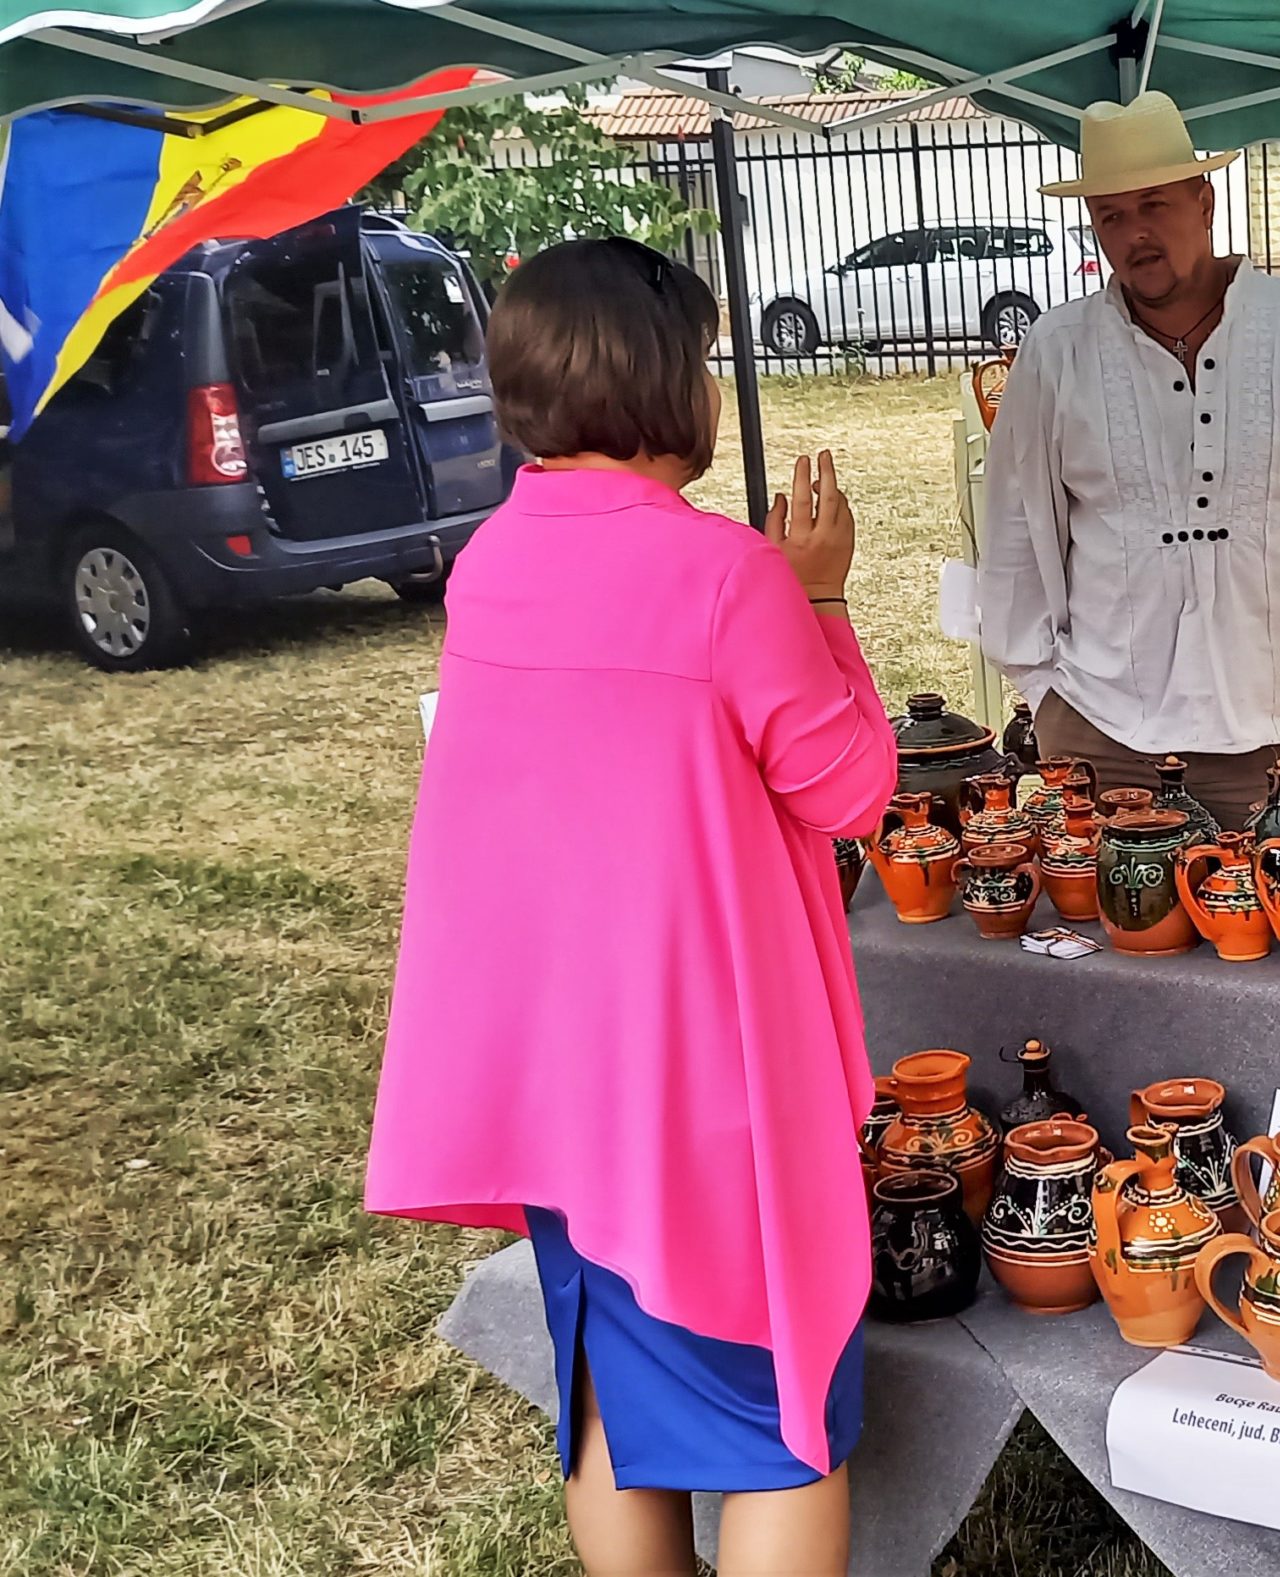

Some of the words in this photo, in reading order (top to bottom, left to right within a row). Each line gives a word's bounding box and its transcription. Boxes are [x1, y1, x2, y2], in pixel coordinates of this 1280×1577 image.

[339, 434, 374, 462] 145
[1172, 1407, 1236, 1438] Leheceni,
[1237, 1420, 1266, 1440] jud.
